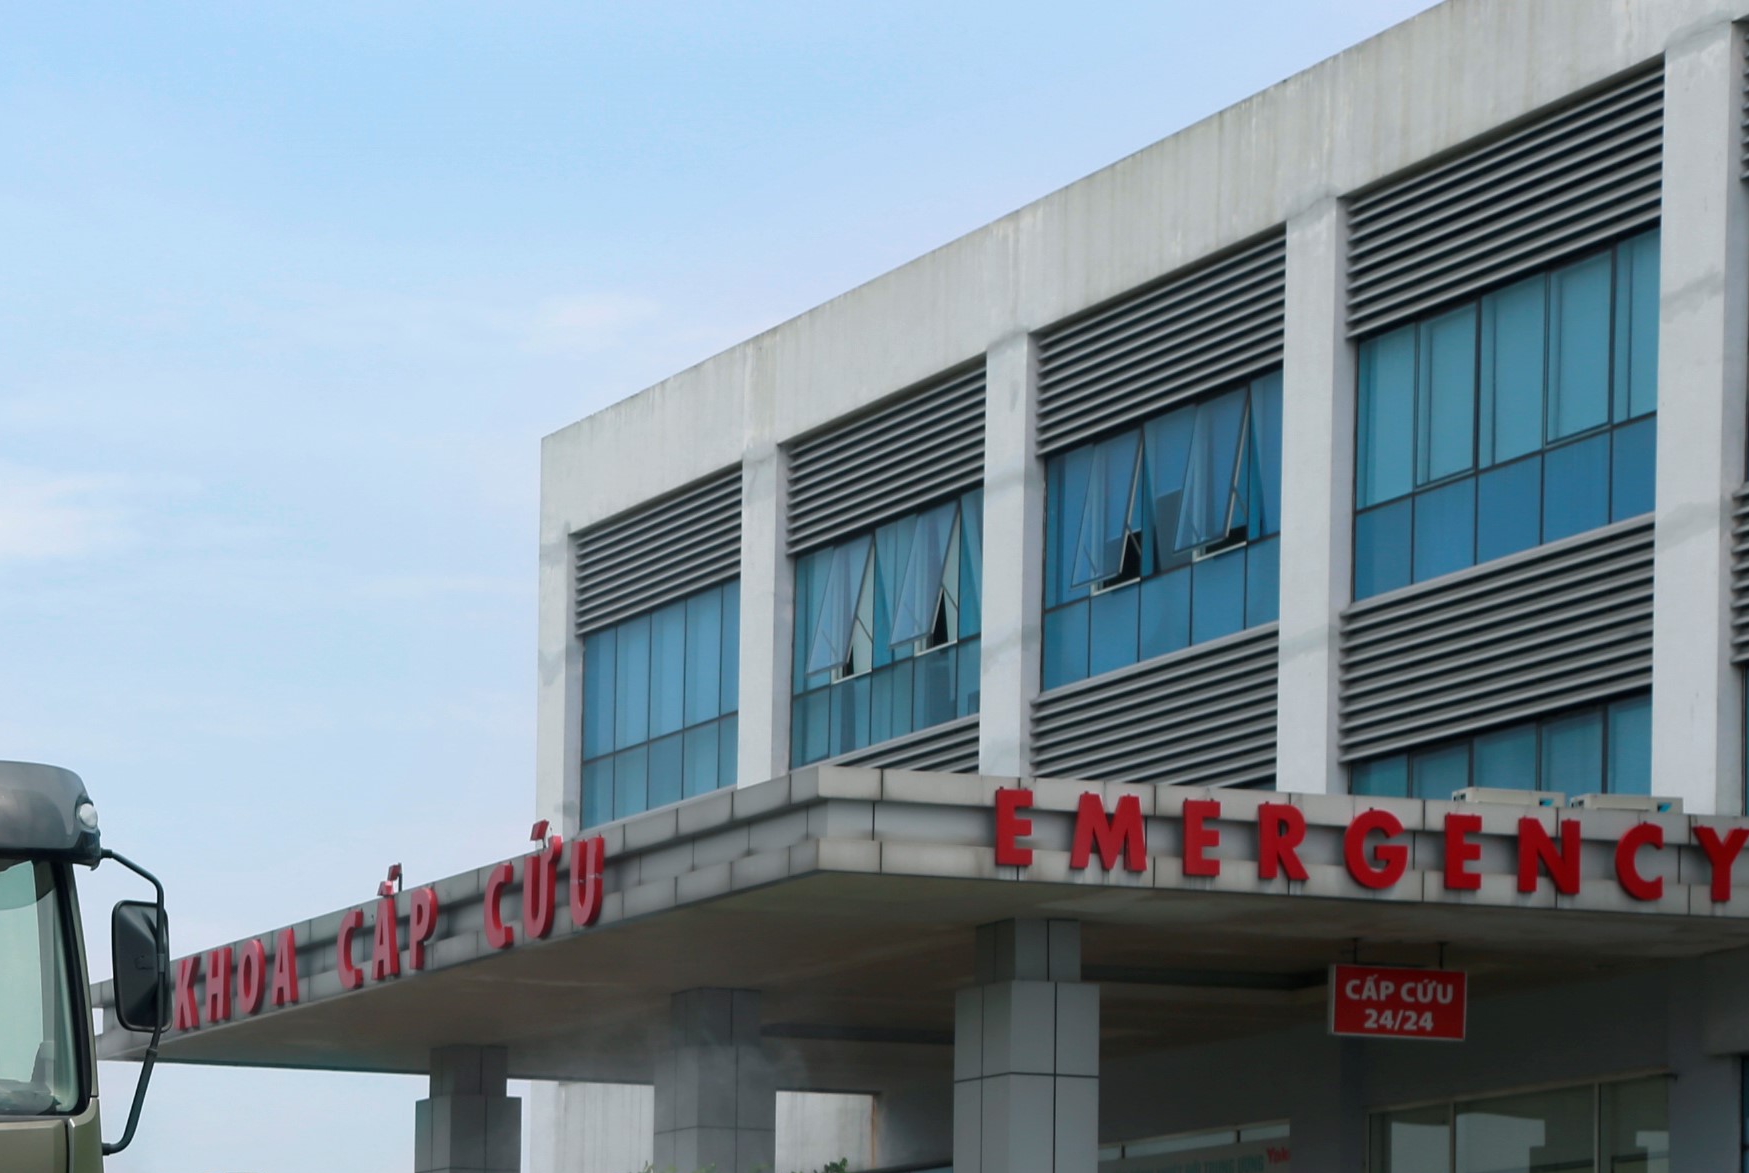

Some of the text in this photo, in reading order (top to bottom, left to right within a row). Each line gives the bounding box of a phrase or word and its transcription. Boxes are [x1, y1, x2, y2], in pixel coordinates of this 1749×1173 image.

[994, 785, 1749, 904] EMERGENCY
[174, 820, 605, 1031] KHOA CẤP CỨU
[1345, 974, 1454, 1005] CẤP CỨU
[1363, 1008, 1434, 1034] 24/24
